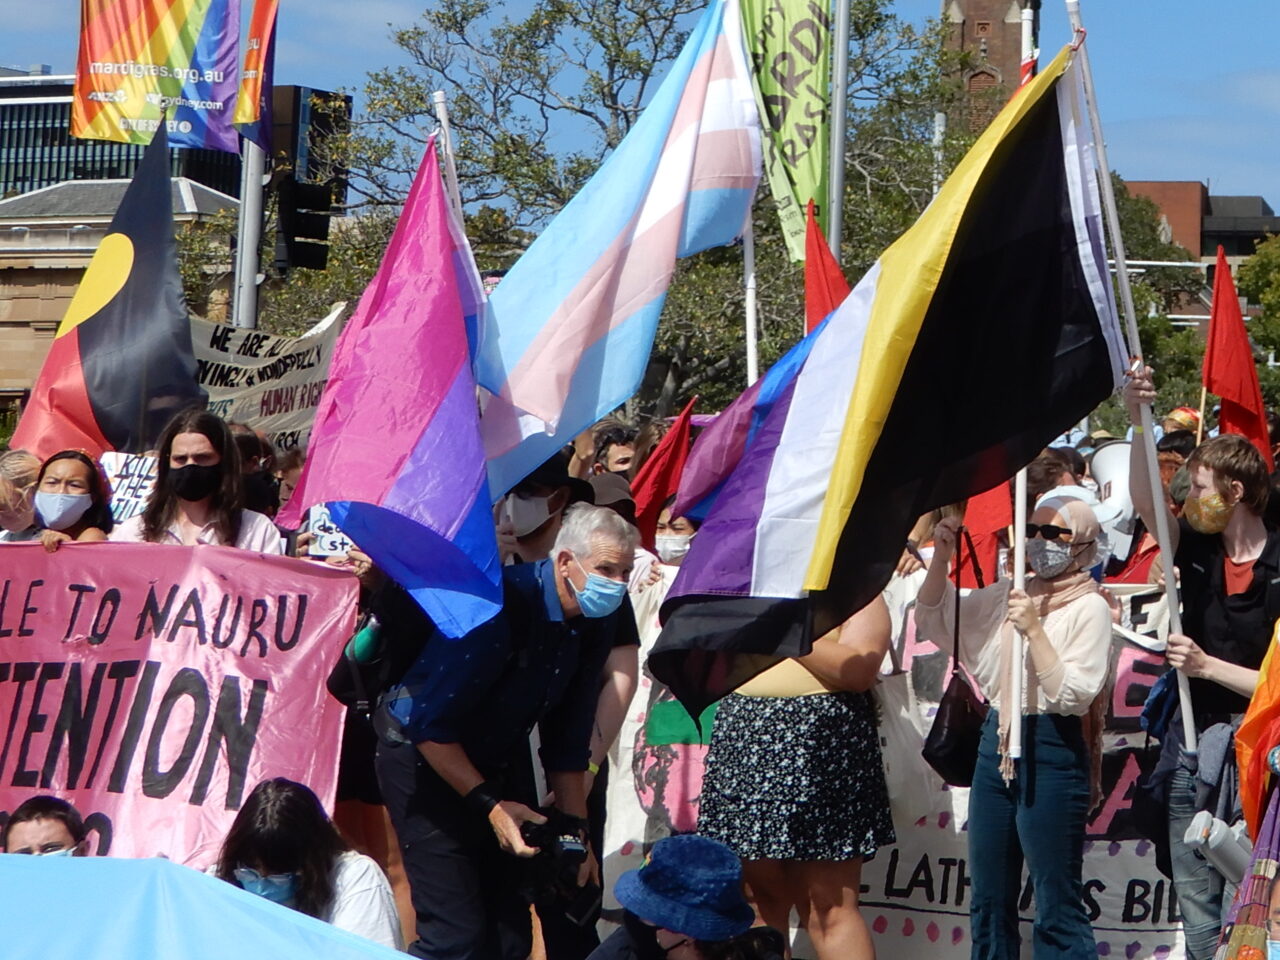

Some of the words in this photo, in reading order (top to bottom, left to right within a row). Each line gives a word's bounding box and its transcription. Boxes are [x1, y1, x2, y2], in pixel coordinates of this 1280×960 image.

[90, 60, 224, 83] mardigras.org.au
[210, 324, 235, 353] WE
[236, 332, 270, 358] ARE
[260, 384, 299, 417] HUMAN
[0, 579, 44, 638] LE
[62, 583, 122, 645] TO
[135, 581, 308, 658] NAURU
[0, 659, 269, 812] TENTION
